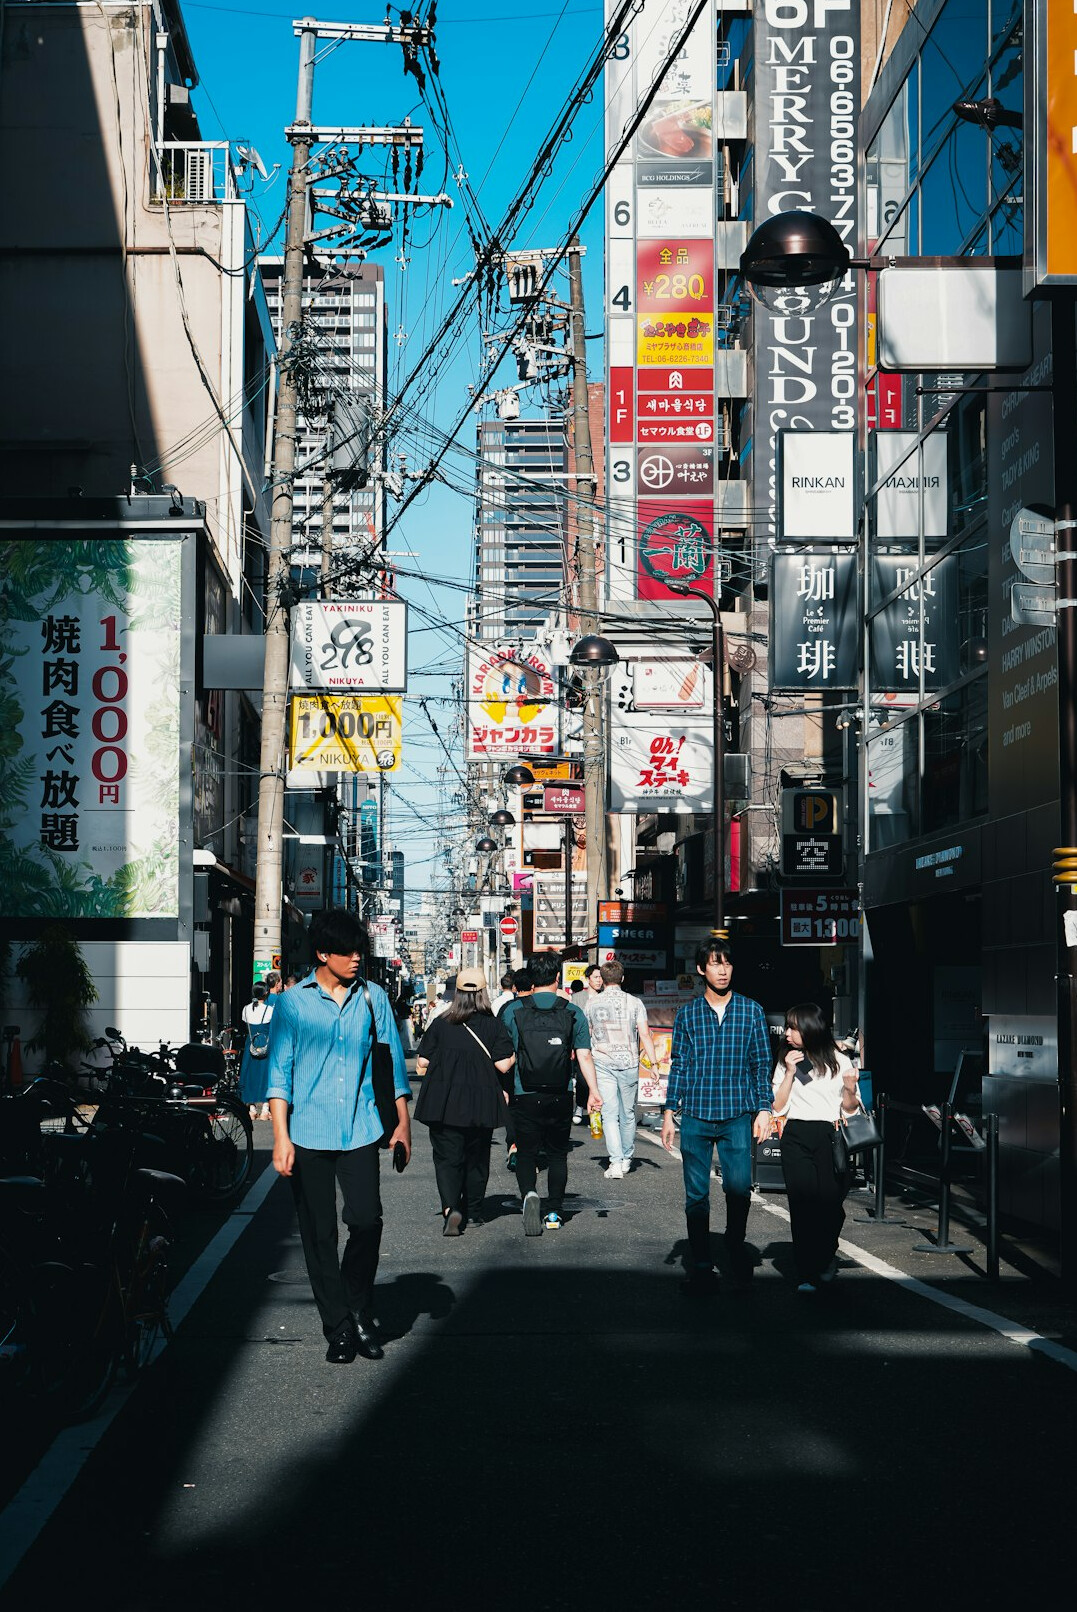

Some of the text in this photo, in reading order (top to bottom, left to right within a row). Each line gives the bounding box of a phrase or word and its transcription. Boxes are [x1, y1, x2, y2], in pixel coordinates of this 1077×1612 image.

[656, 174, 690, 182] HOLDINGS
[614, 200, 631, 226] 6
[765, 36, 818, 404] MERRY GOUND
[659, 247, 689, 265] 全品
[612, 285, 632, 311] 4
[646, 398, 707, 412] 새마을식당
[640, 426, 710, 436] セマウル食堂 1F
[613, 460, 631, 482] 3
[792, 476, 845, 489] RINKAN
[617, 536, 626, 564] 1
[643, 523, 706, 574] 一蘭
[323, 605, 373, 613] YAKINIKU
[806, 608, 815, 617] Le
[802, 616, 829, 625] Premier
[808, 624, 824, 633] Café
[304, 605, 313, 684] ALL YOU CAN EAT
[382, 605, 390, 684] ALL YOU CAN EAT
[1001, 644, 1024, 675] HARRY
[329, 677, 365, 685] NIKUYA
[1002, 687, 1014, 710] Van
[1014, 678, 1030, 704] Cleef
[1036, 664, 1057, 695] Arpels
[40, 614, 82, 852] 焼肉食べ放題
[472, 726, 555, 744] ジャンカラ
[1002, 720, 1032, 748] and more
[320, 753, 369, 764] NIKUYA
[649, 755, 679, 771] マイ
[635, 769, 690, 788] ステーキ
[796, 837, 829, 870] 空
